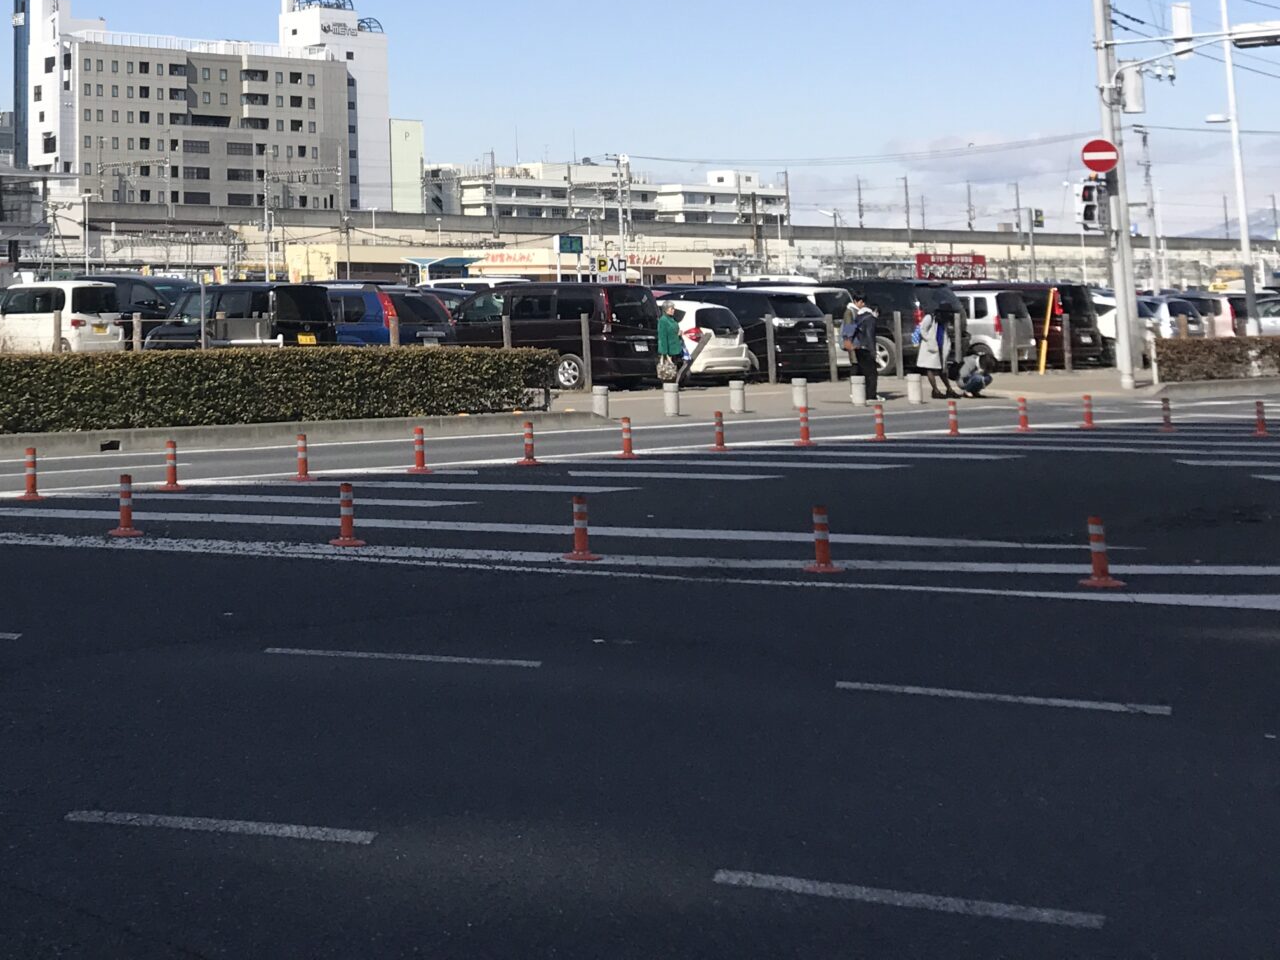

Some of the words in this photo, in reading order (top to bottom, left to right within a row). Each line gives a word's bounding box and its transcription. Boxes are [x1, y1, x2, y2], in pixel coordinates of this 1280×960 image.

[404, 131, 410, 141] P
[599, 259, 607, 271] P
[608, 258, 627, 272] 入口
